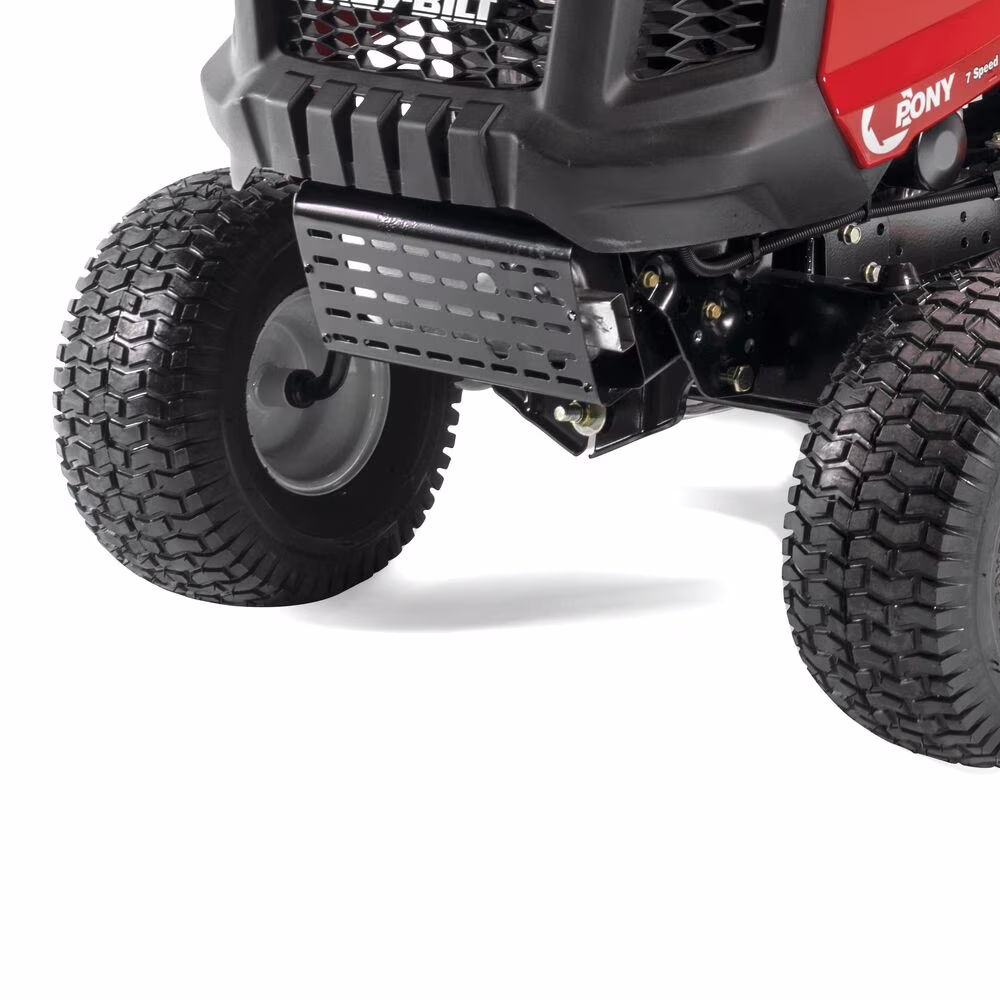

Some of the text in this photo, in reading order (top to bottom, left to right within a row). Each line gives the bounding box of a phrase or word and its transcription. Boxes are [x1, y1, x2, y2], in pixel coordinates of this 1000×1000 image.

[965, 54, 999, 85] 7 Speed
[895, 72, 956, 129] PONY
